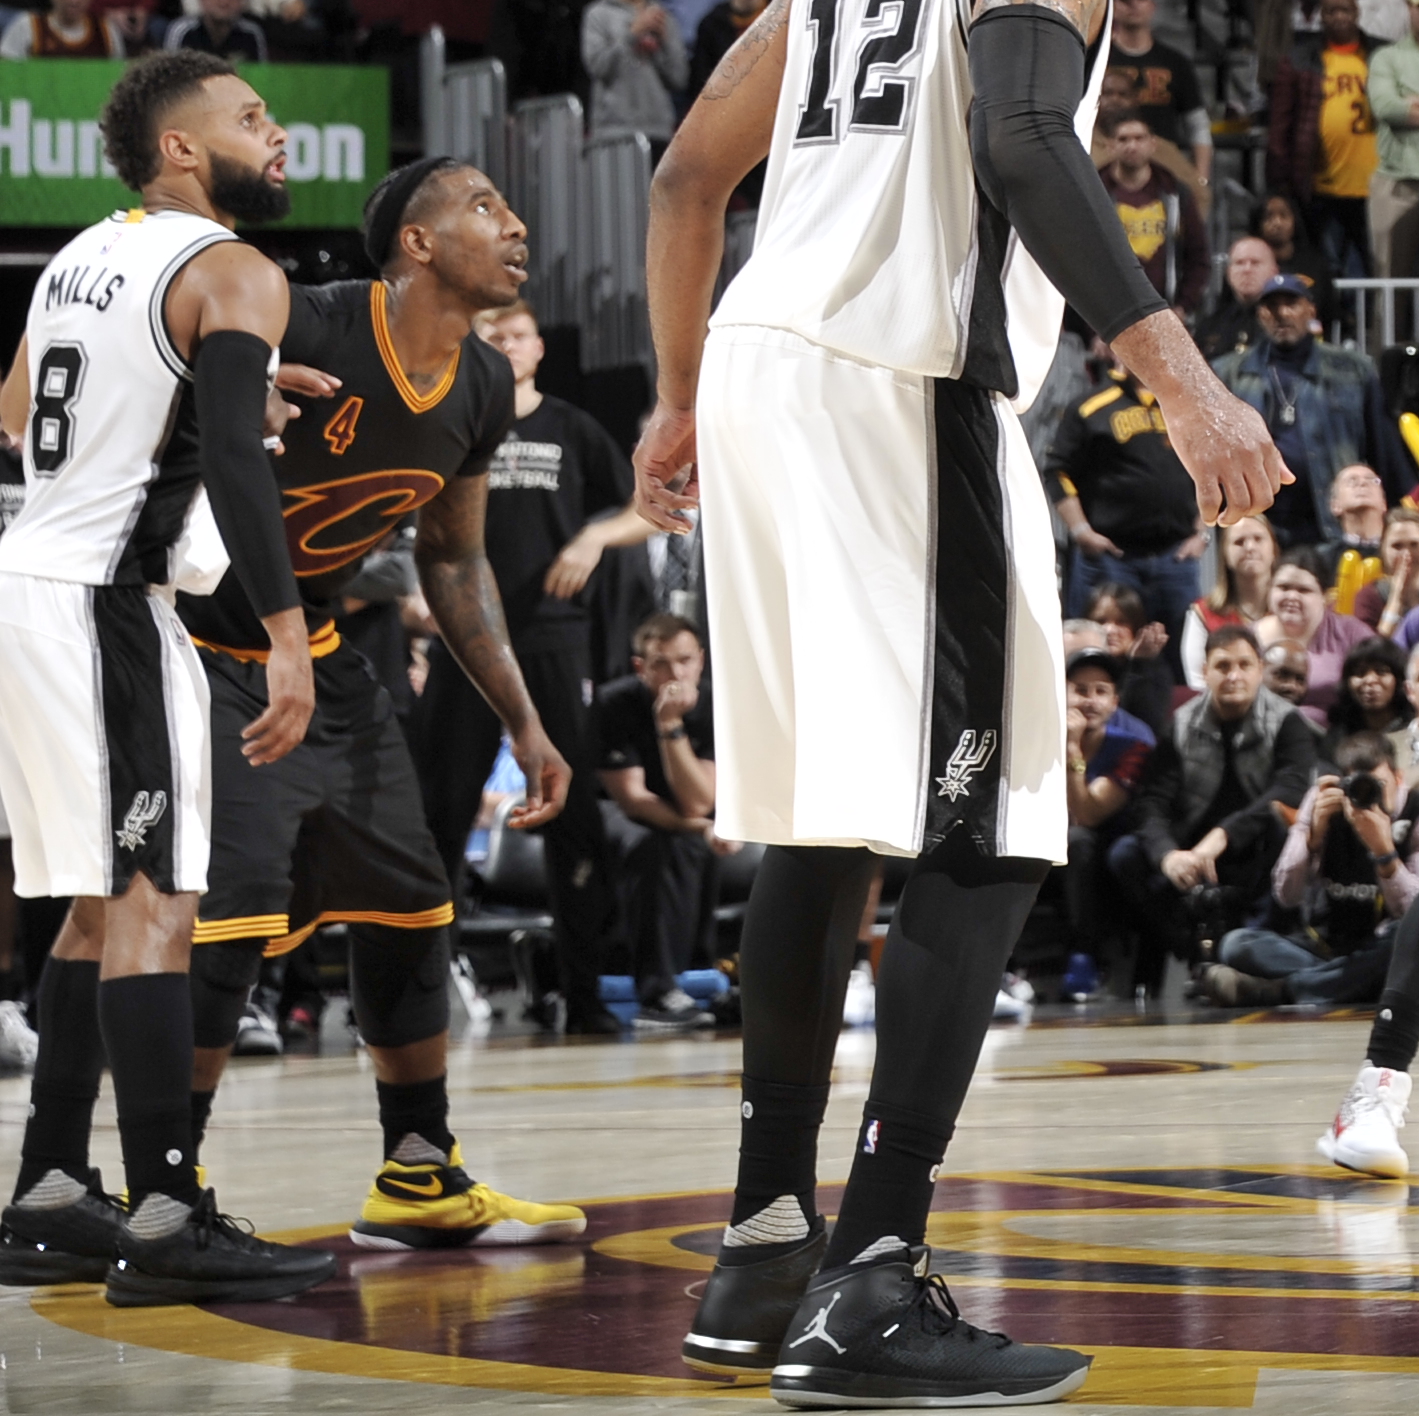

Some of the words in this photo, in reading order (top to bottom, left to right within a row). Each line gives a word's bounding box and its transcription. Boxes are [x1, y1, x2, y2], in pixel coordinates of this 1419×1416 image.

[46, 266, 125, 313] MILLS
[30, 339, 90, 478] 8
[324, 395, 365, 455] 4
